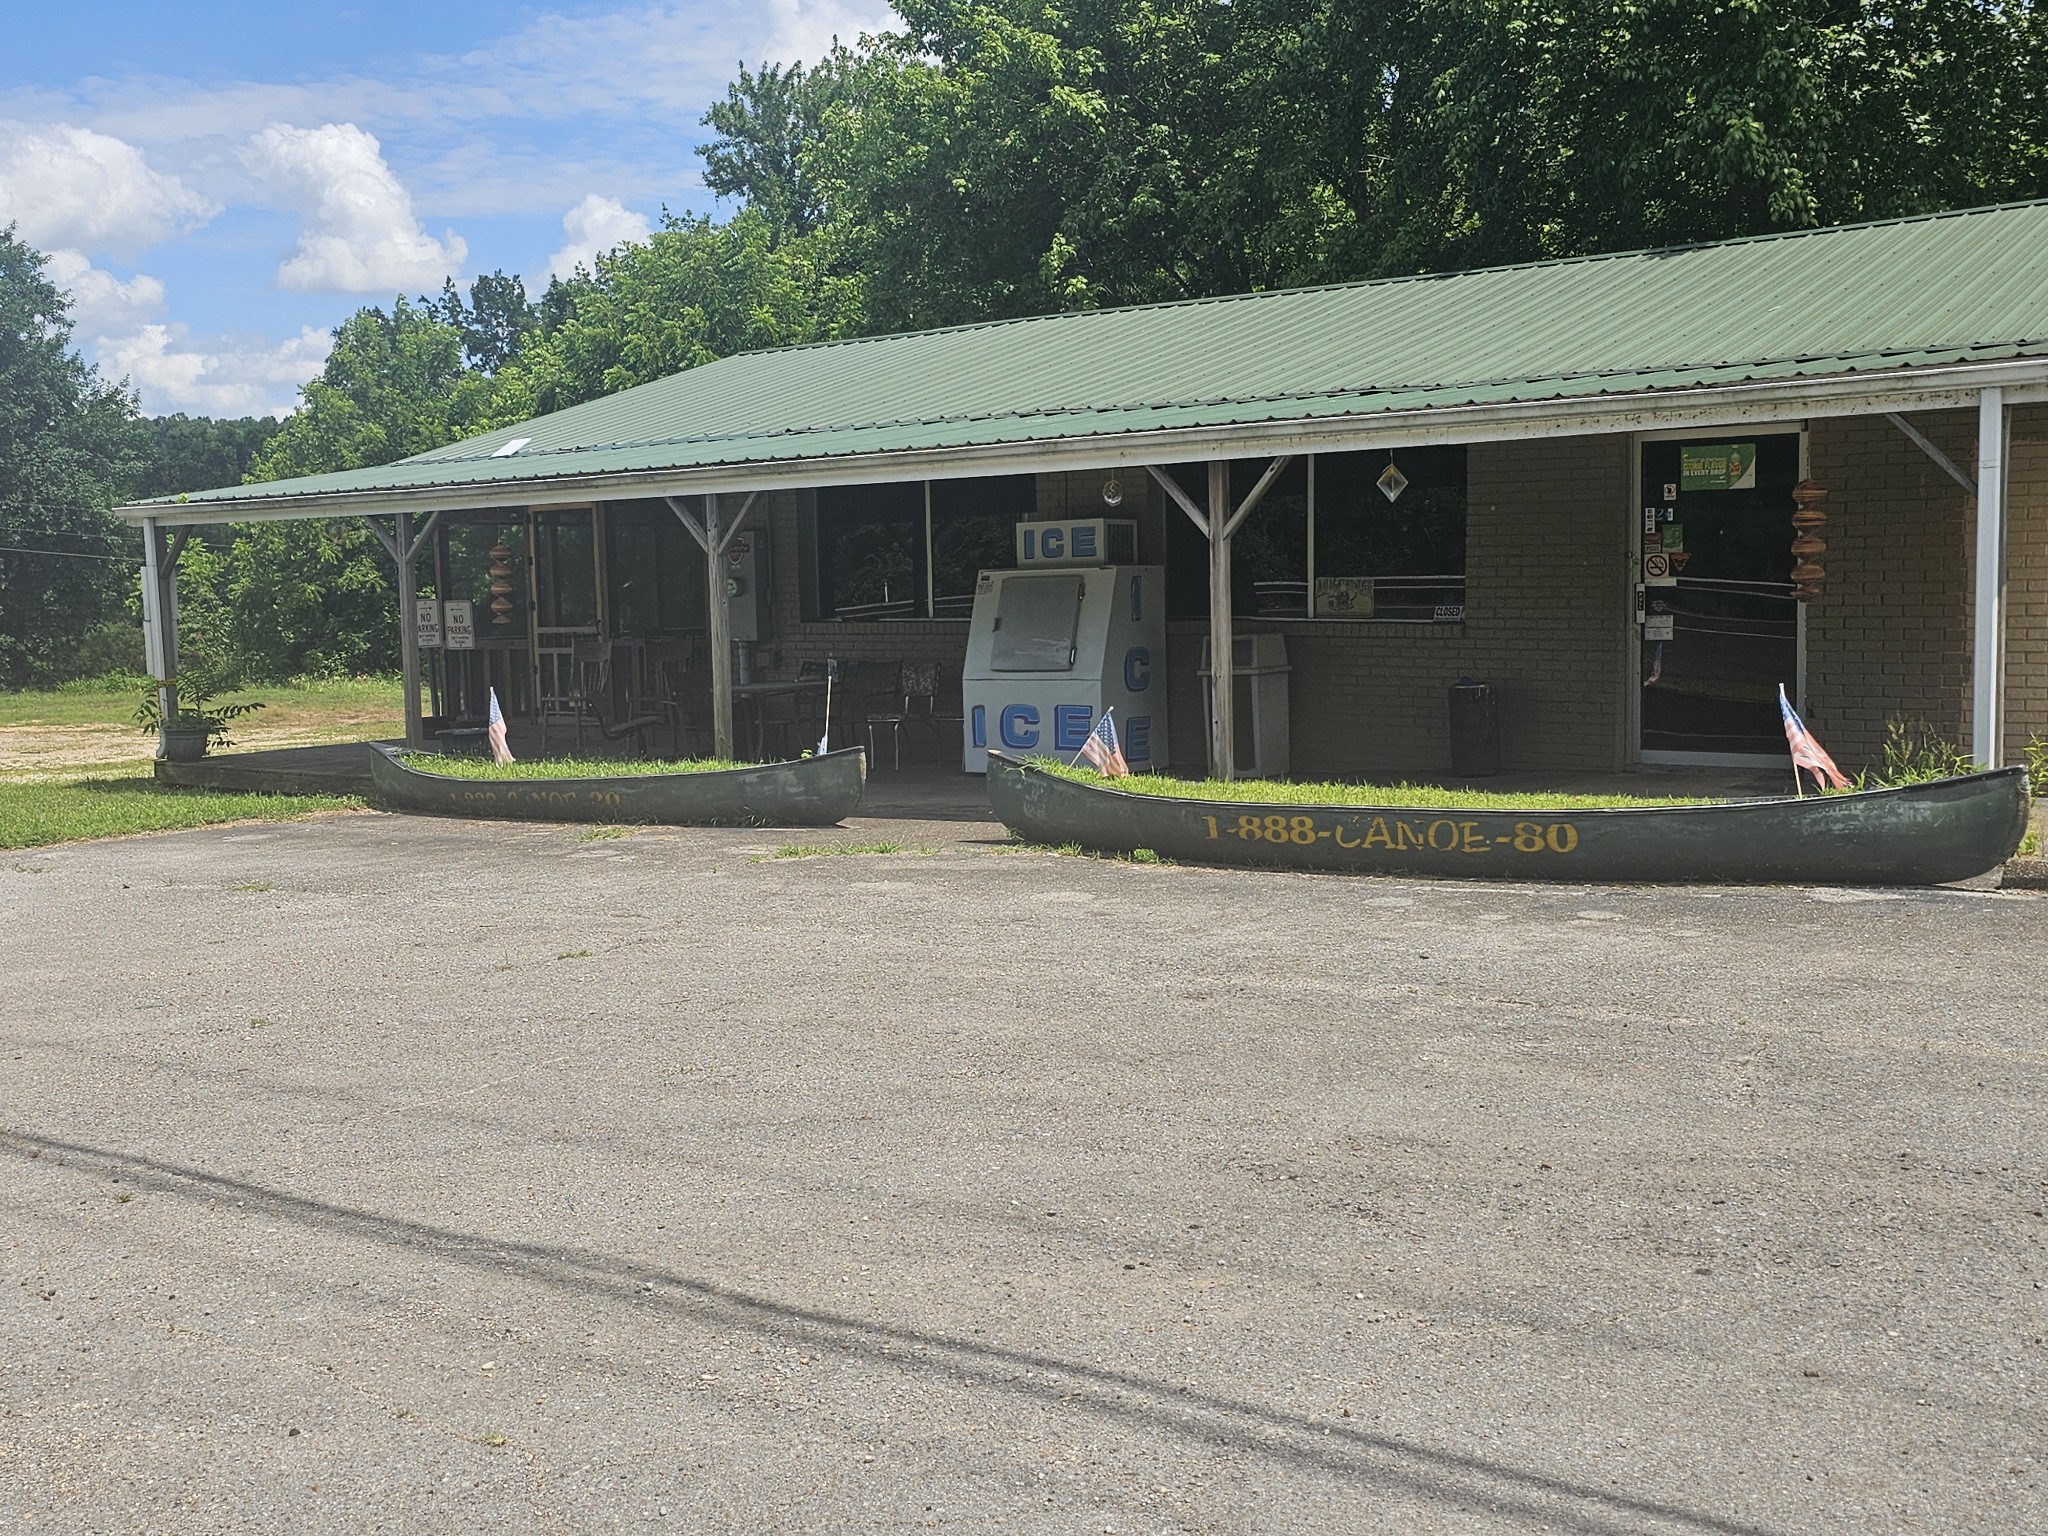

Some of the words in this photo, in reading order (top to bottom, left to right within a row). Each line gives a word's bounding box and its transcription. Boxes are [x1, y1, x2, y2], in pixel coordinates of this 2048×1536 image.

[1024, 526, 1097, 559] ICE
[1436, 607, 1460, 616] CLOSED
[420, 613, 431, 622] NO
[453, 615, 464, 624] NO
[418, 624, 438, 632] ARKING
[447, 626, 471, 634] PARKING
[1124, 575, 1151, 762] ICE
[972, 704, 1093, 751] ICE
[1201, 814, 1579, 853] 1-888-CANOE-80
